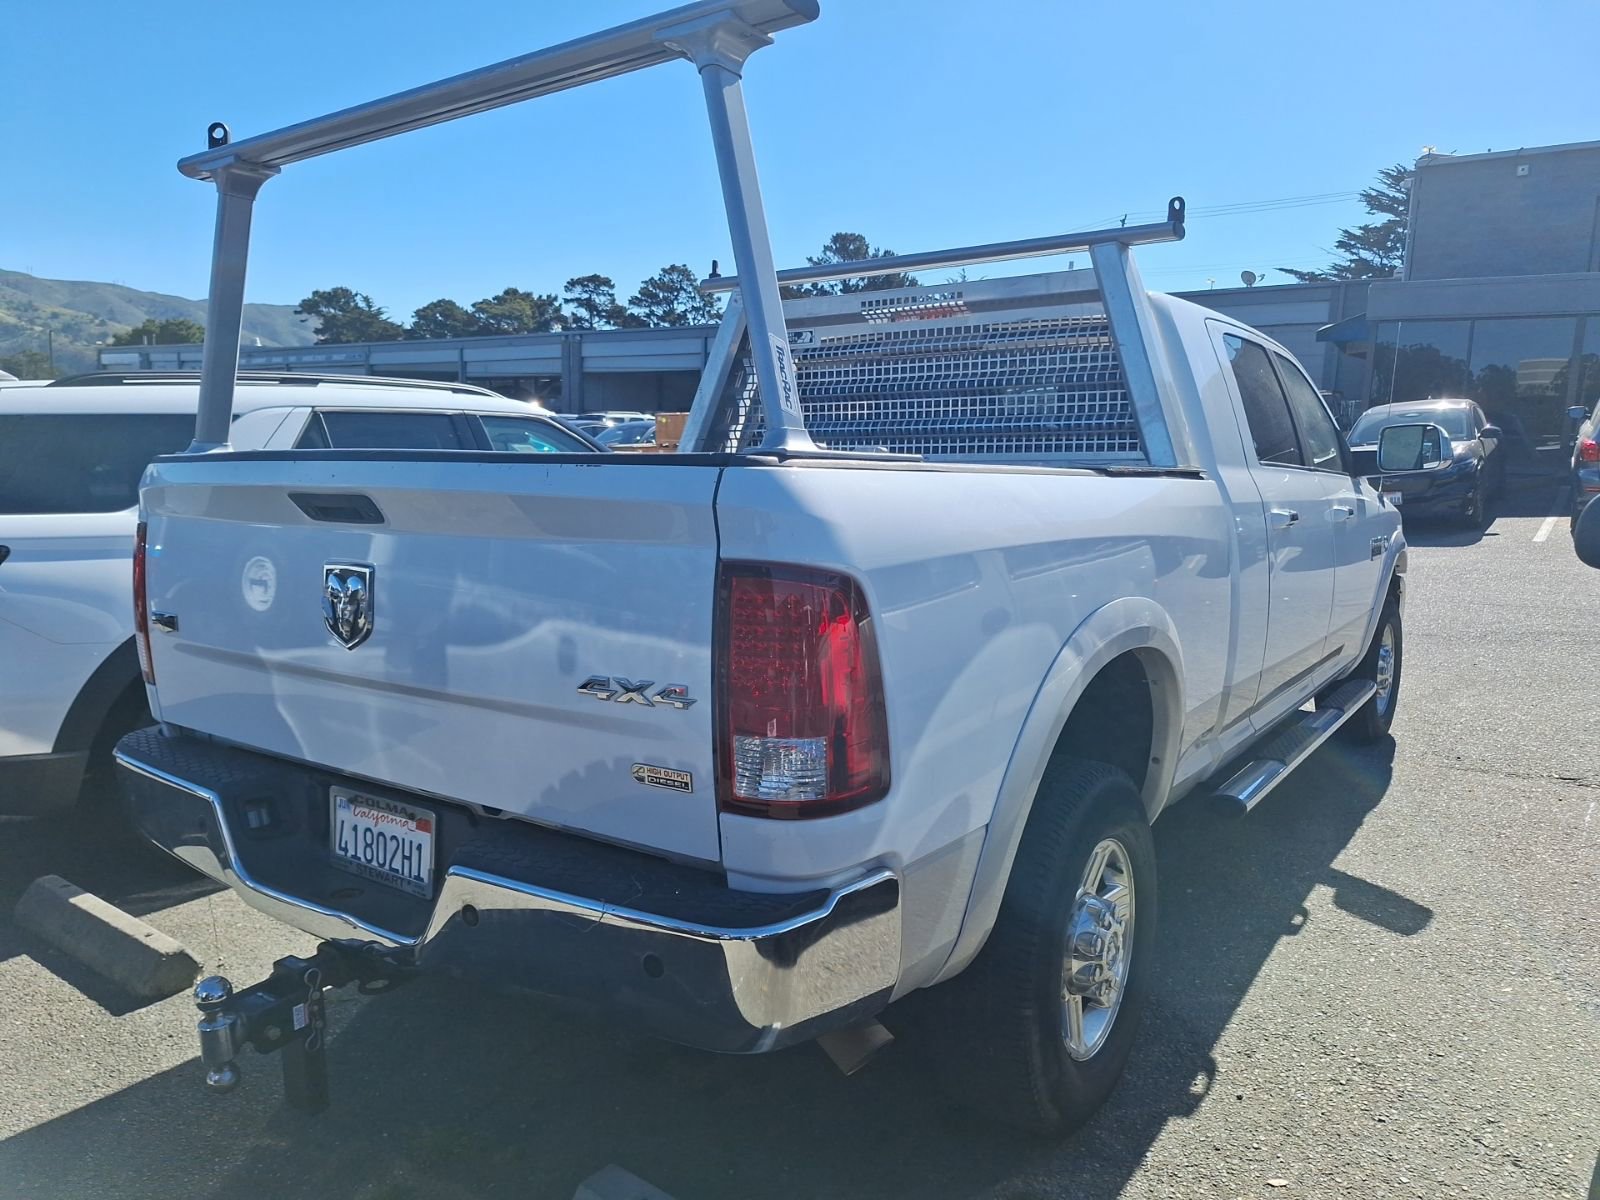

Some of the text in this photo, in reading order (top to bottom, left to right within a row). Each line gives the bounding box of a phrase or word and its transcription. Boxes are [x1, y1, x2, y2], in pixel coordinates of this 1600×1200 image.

[646, 767, 689, 781] HIGH OUTPUT
[648, 777, 689, 789] DIESEL
[353, 795, 408, 816] COLMA
[352, 805, 416, 832] California
[338, 820, 425, 883] 41802H1
[356, 863, 404, 889] STEWART
